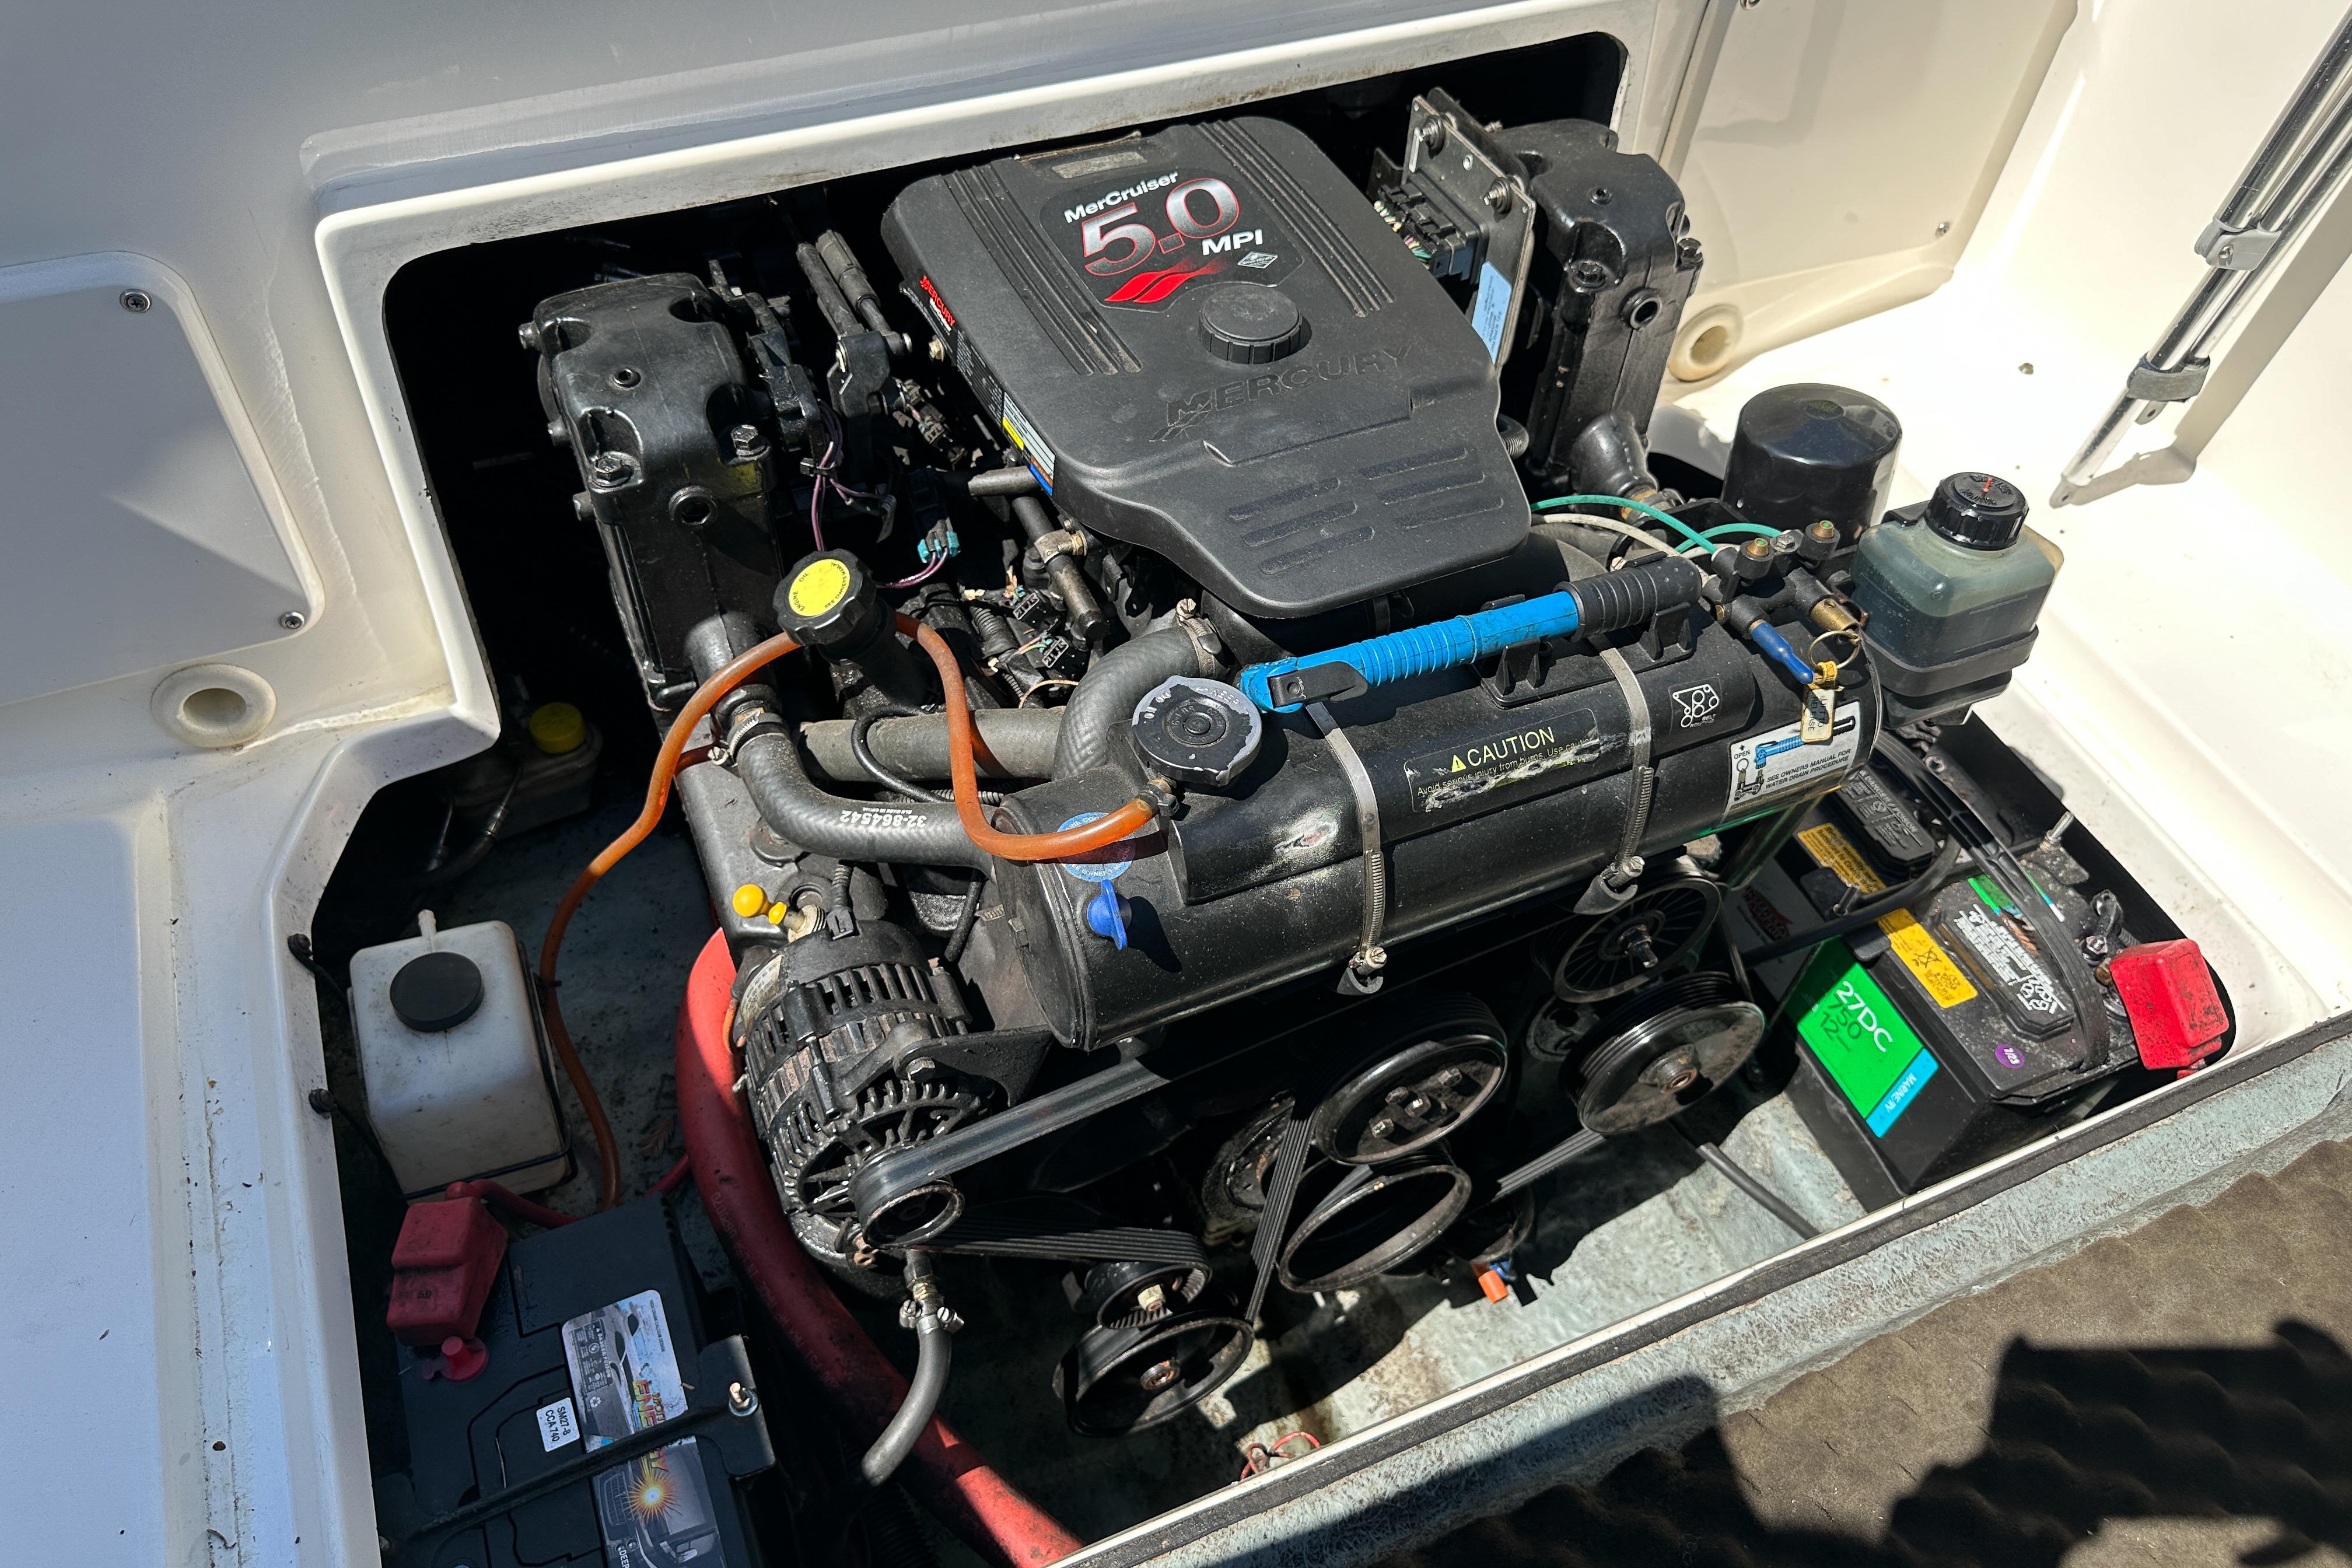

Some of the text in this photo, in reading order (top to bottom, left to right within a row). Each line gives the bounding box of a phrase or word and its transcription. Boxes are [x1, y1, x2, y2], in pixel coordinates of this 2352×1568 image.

[1063, 172, 1178, 223] MerCruiser
[1082, 178, 1240, 276] 5.0
[1202, 229, 1263, 256] MPI
[919, 275, 956, 326] MERCURY
[1150, 345, 1412, 440] MERCURY
[831, 562, 845, 575] MANUAL
[793, 573, 810, 611] ENGINE OIL
[835, 576, 846, 599] OWNERS
[1690, 719, 1714, 728] ROUTING
[1807, 696, 1818, 731] RELEASE
[1467, 727, 1555, 766] CAUTION
[1734, 750, 1750, 760] OPEN
[1417, 782, 1440, 796] Avoid
[1443, 774, 1472, 789] serious
[1475, 765, 1497, 781] injury
[1499, 759, 1518, 771] from
[1547, 747, 1560, 757] Use
[1766, 755, 1850, 789] WATER DRAIN PROCEDURE
[1767, 748, 1851, 782] SEE OWNERS MANUAL FOR
[839, 810, 928, 828] 32-864542
[1082, 868, 1113, 876] OWNERS
[1821, 1012, 1839, 1041] 12
[1828, 993, 1862, 1040] 750
[1836, 981, 1893, 1053] 27DC
[545, 1409, 561, 1442] CCA 740
[557, 1405, 571, 1436] SM27-8
